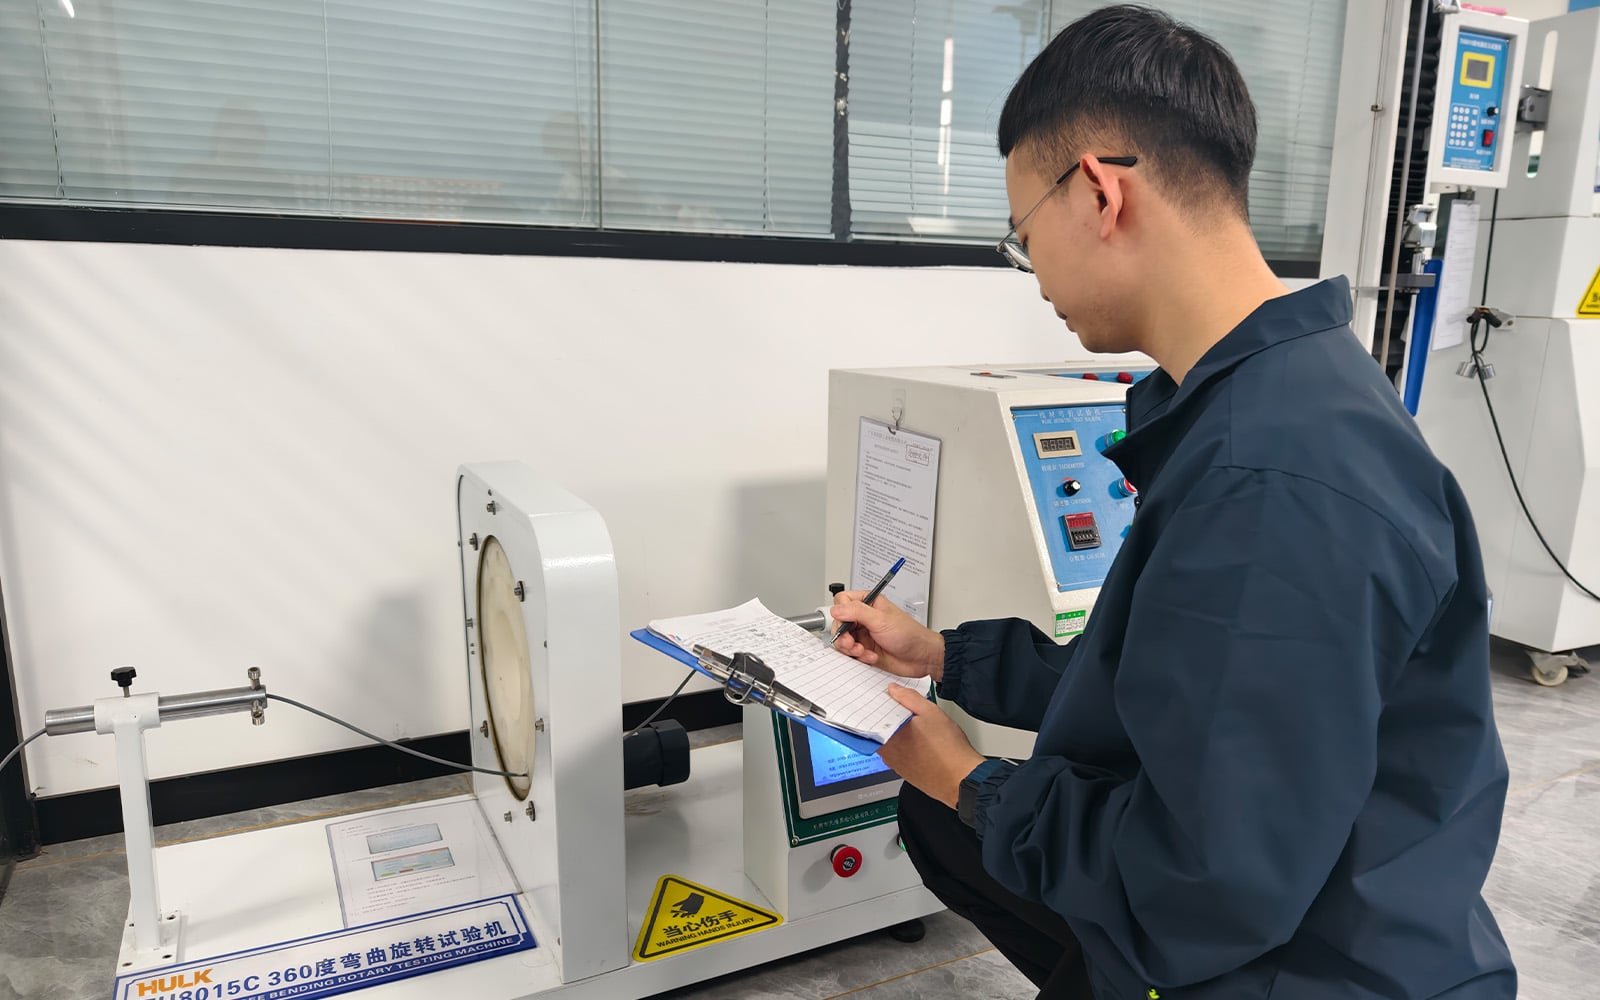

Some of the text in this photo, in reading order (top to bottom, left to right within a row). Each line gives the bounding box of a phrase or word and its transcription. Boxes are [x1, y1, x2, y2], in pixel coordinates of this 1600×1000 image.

[656, 916, 755, 948] WARNING HANDS INJURY
[663, 909, 738, 938] 当心伤手
[144, 920, 507, 1000] 8015C 360度弯曲旋转试验机
[269, 937, 515, 999] BENDING ROTARY TESTING MACHINE
[136, 968, 213, 997] HULK
